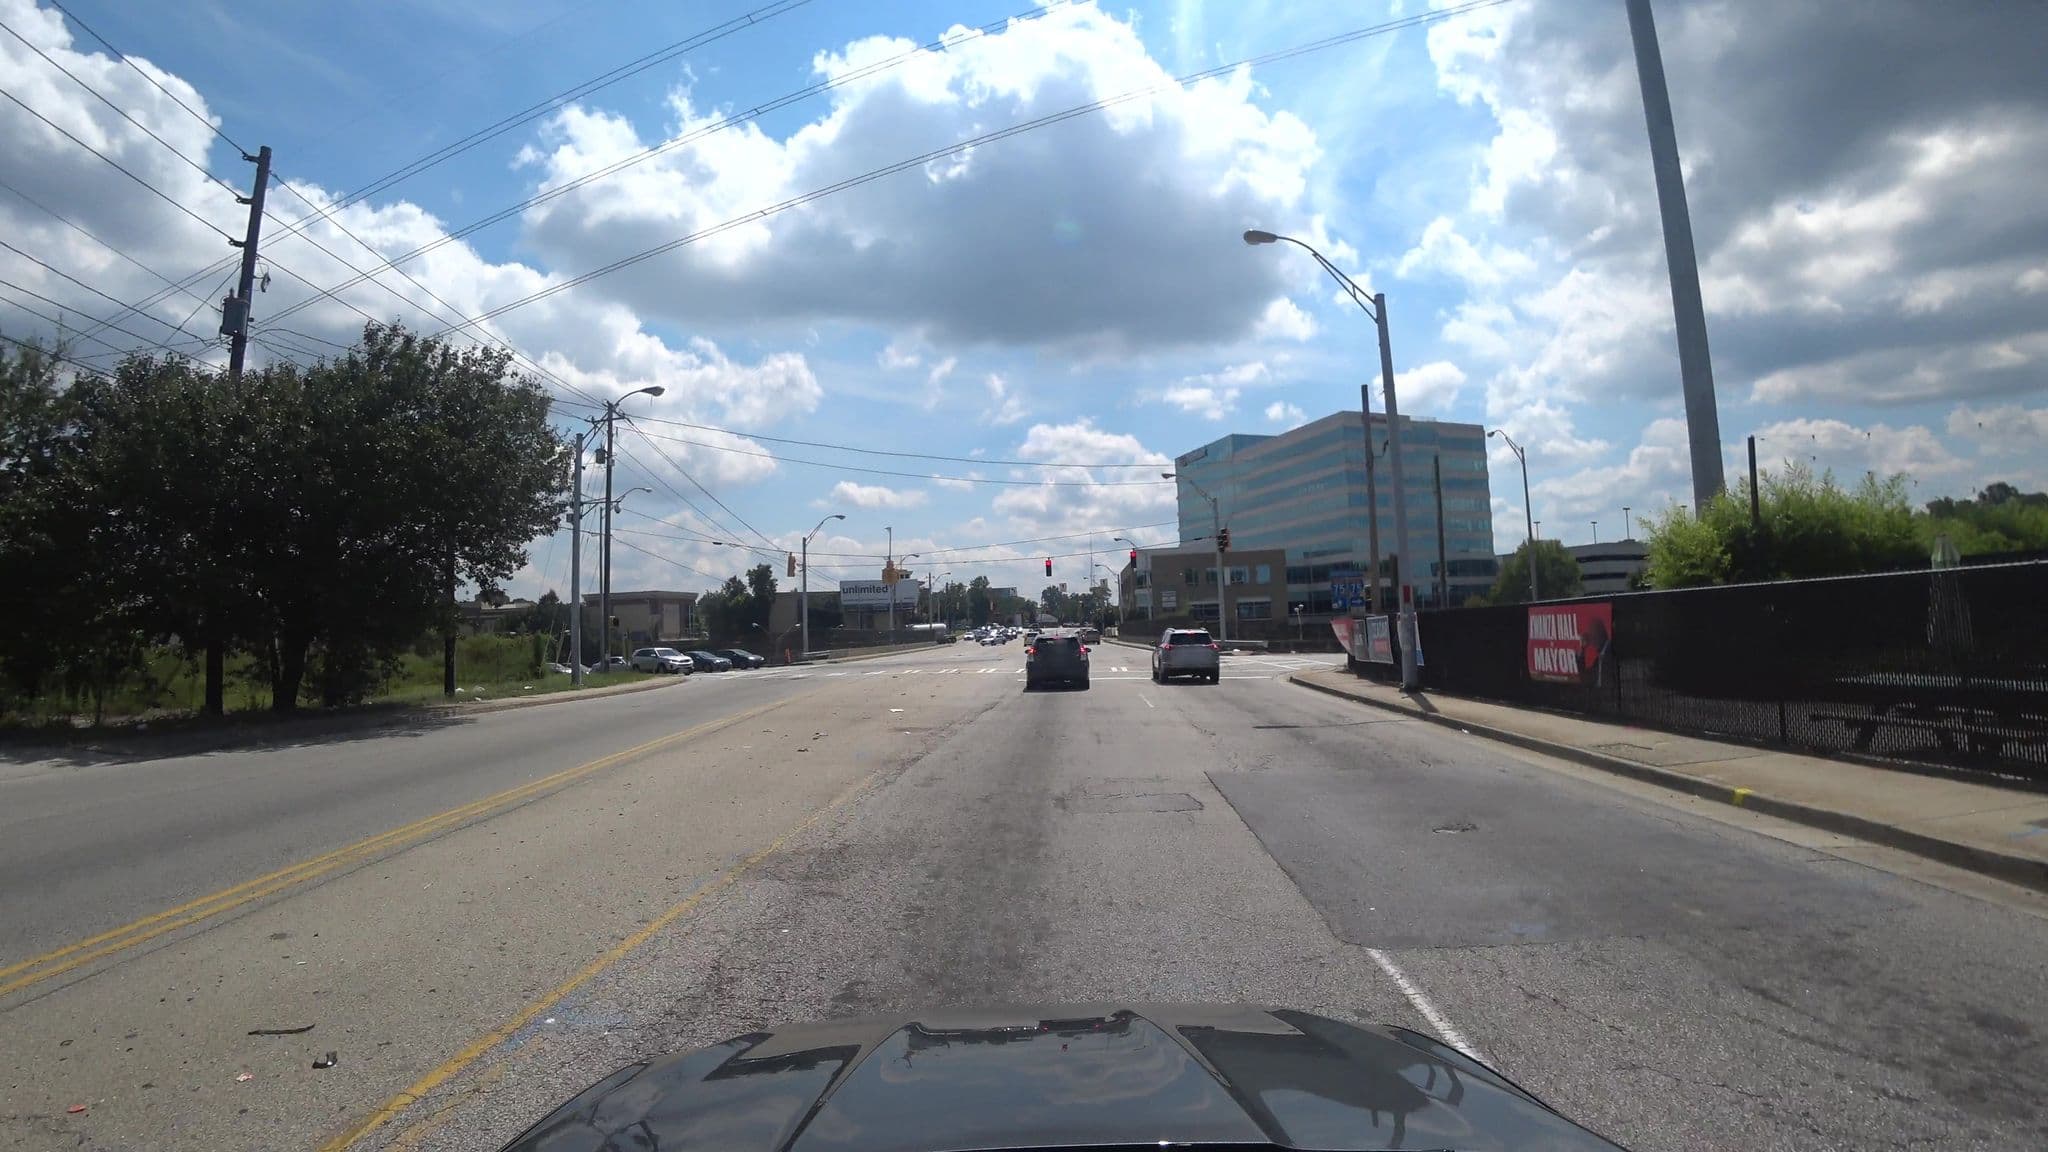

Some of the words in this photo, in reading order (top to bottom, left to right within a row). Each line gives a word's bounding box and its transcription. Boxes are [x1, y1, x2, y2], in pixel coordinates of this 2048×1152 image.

[842, 584, 889, 594] unlimited
[1557, 613, 1581, 640] HALL
[1534, 647, 1579, 674] MAYOR
